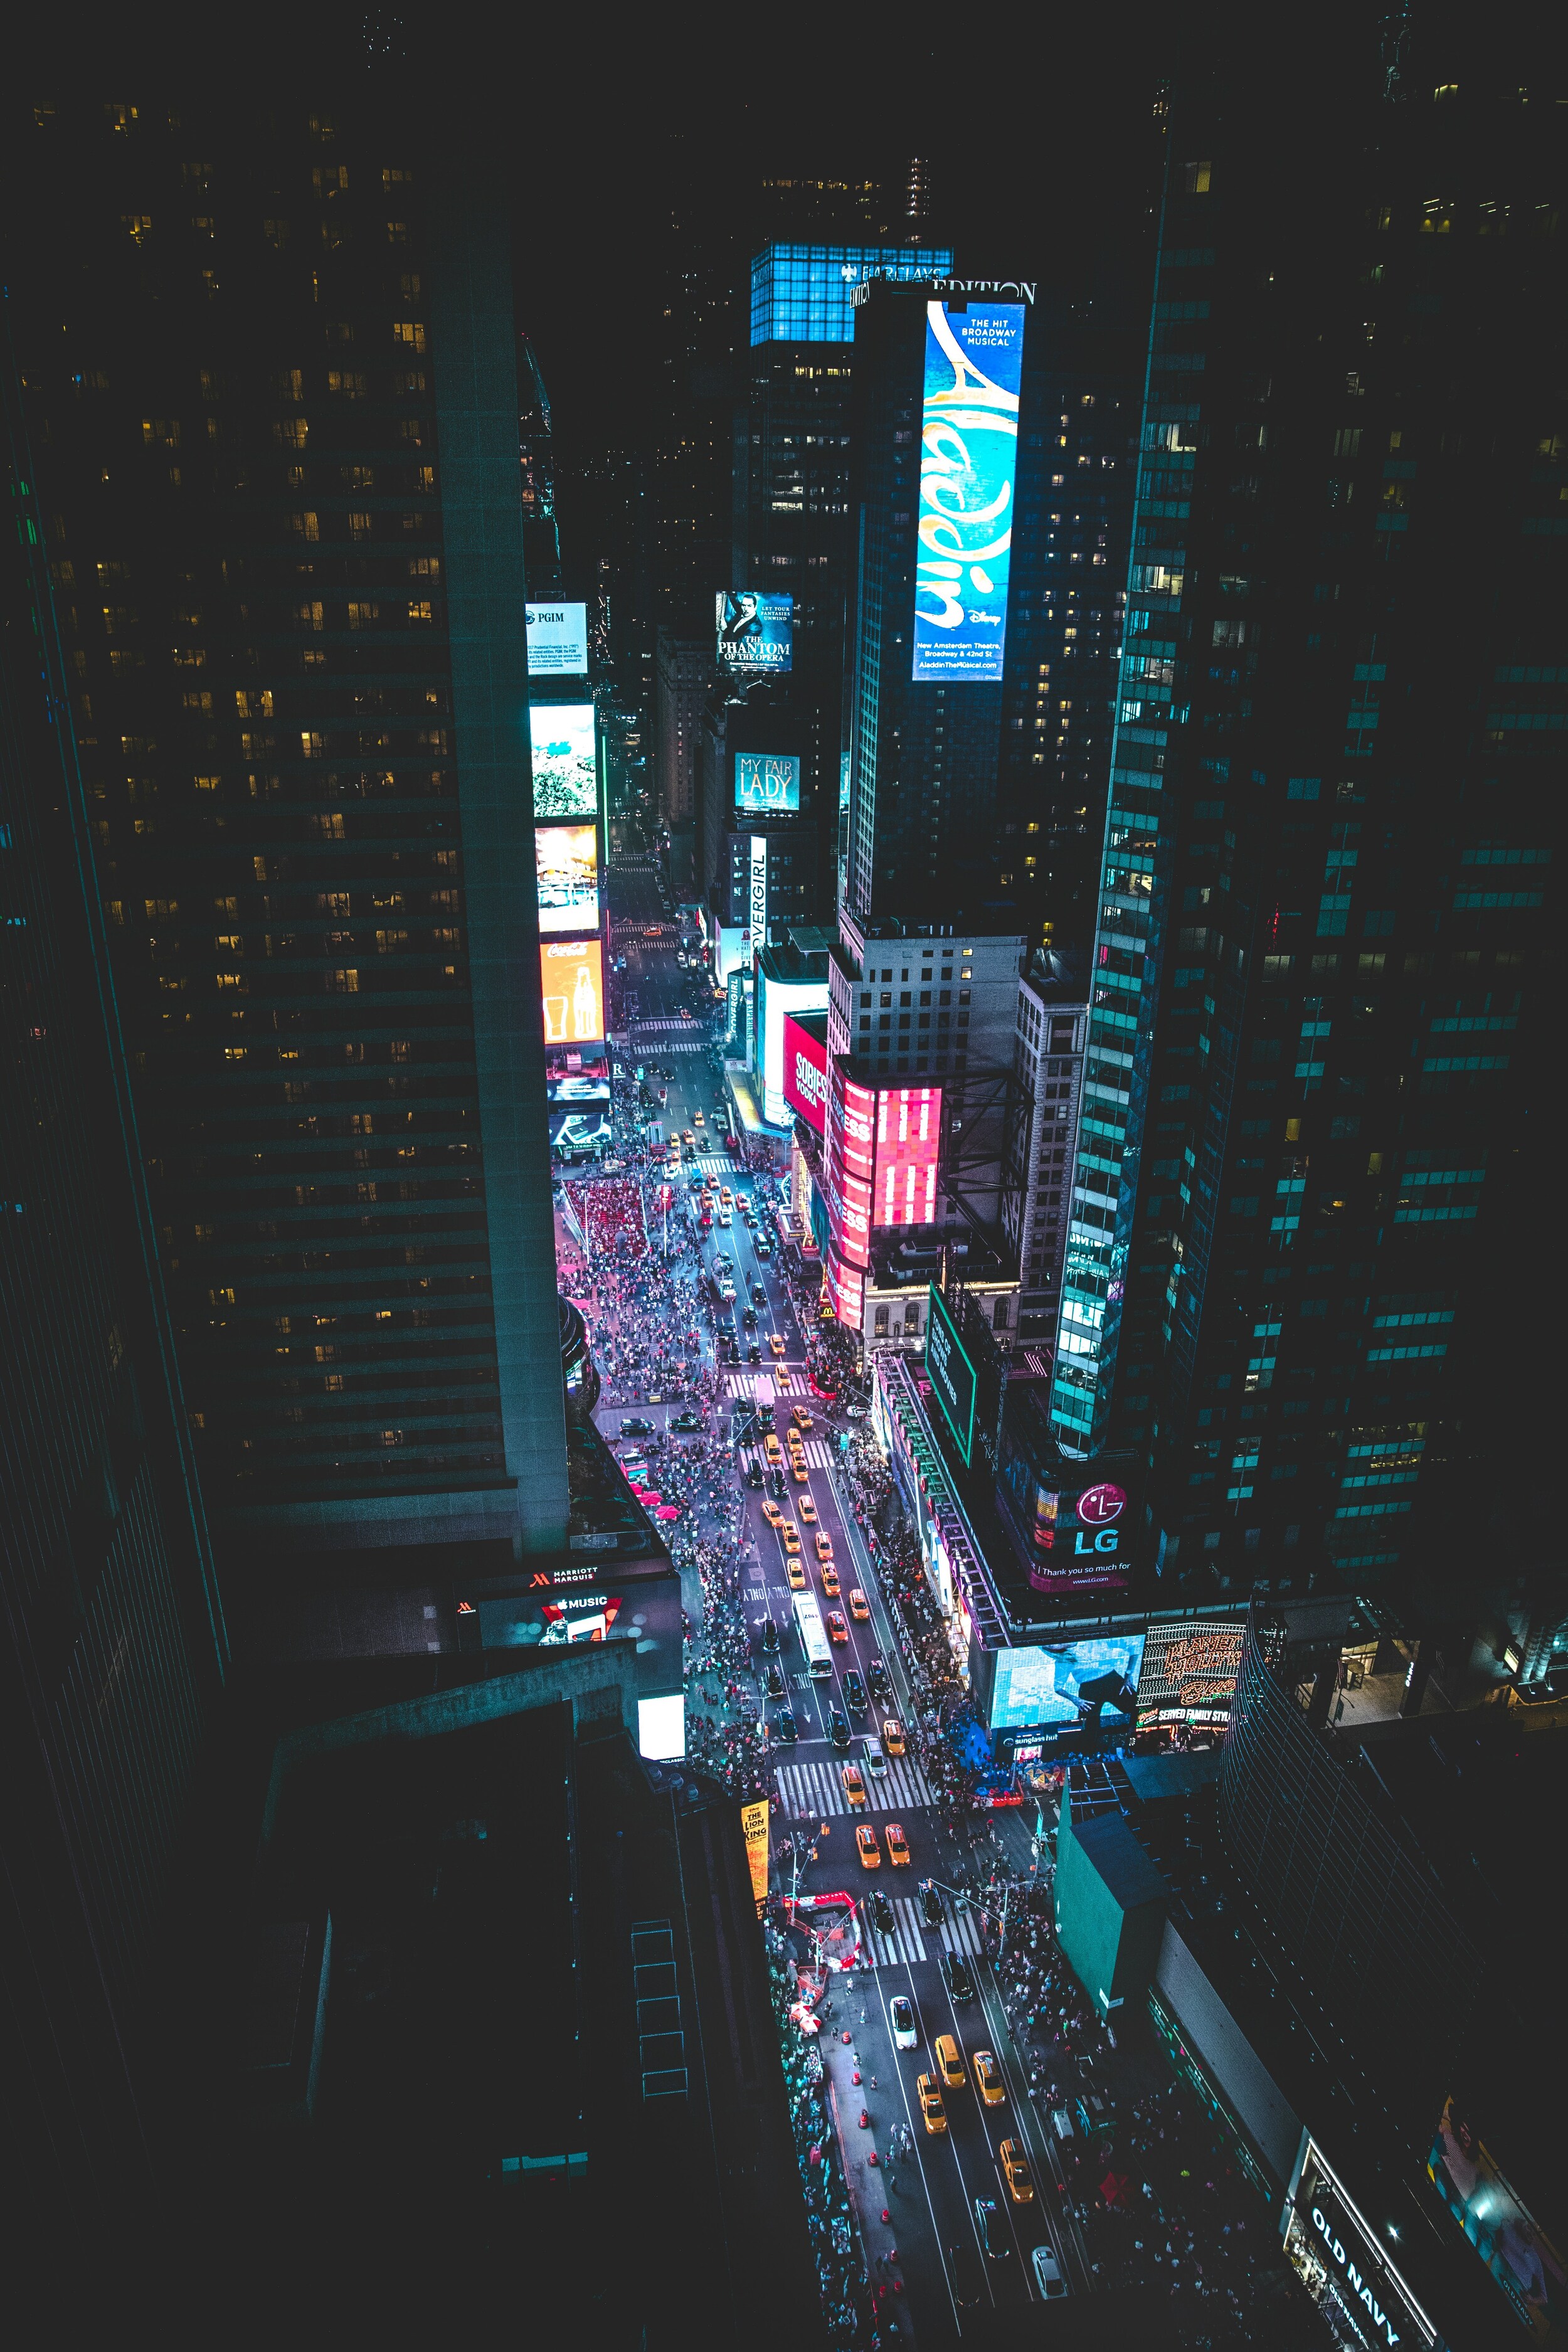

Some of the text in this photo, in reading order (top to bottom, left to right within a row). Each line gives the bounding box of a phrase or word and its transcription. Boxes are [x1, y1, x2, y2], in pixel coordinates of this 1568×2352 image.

[971, 319, 1009, 328] THE HIT
[961, 328, 1016, 337] BROADWAY
[967, 337, 1009, 346] MUSICAL
[538, 613, 564, 622] PGIM
[968, 610, 1001, 627] Disney
[718, 642, 790, 655] PHANTOM
[741, 758, 792, 776] MY FAIR
[740, 772, 792, 798] LADY
[730, 978, 738, 1034] COVERGIRL
[613, 1063, 625, 1075] R
[796, 1078, 817, 1108] VODKA
[933, 1311, 951, 1357] TONS OF
[931, 1327, 948, 1367] SHOWS
[930, 1342, 957, 1406] AND MOVIES
[1074, 1529, 1119, 1555] LG
[554, 1567, 598, 1577] MARRIOTT
[554, 1574, 593, 1583] MARQUIS
[1042, 1568, 1066, 1576] Thank
[1067, 1568, 1083, 1579] you
[743, 1588, 764, 1601] ONLY
[768, 1586, 790, 1599] ONLY
[569, 1596, 607, 1609] MUSIC
[1165, 1635, 1244, 1668] PLANET
[788, 1673, 812, 1690] ONLY
[1158, 1708, 1186, 1721] SERVED
[1186, 1708, 1212, 1720] FAMILY
[1212, 1710, 1231, 1722] STYL
[1015, 1734, 1059, 1745] sunglass hut
[747, 1811, 761, 1821] THE
[745, 1818, 764, 1831] LION
[744, 1827, 766, 1841] KING
[1313, 2207, 1400, 2346] OLD NAVY
[1503, 2280, 1533, 2324] OLD NAVY
[1328, 2284, 1364, 2339] OLD NAVY
